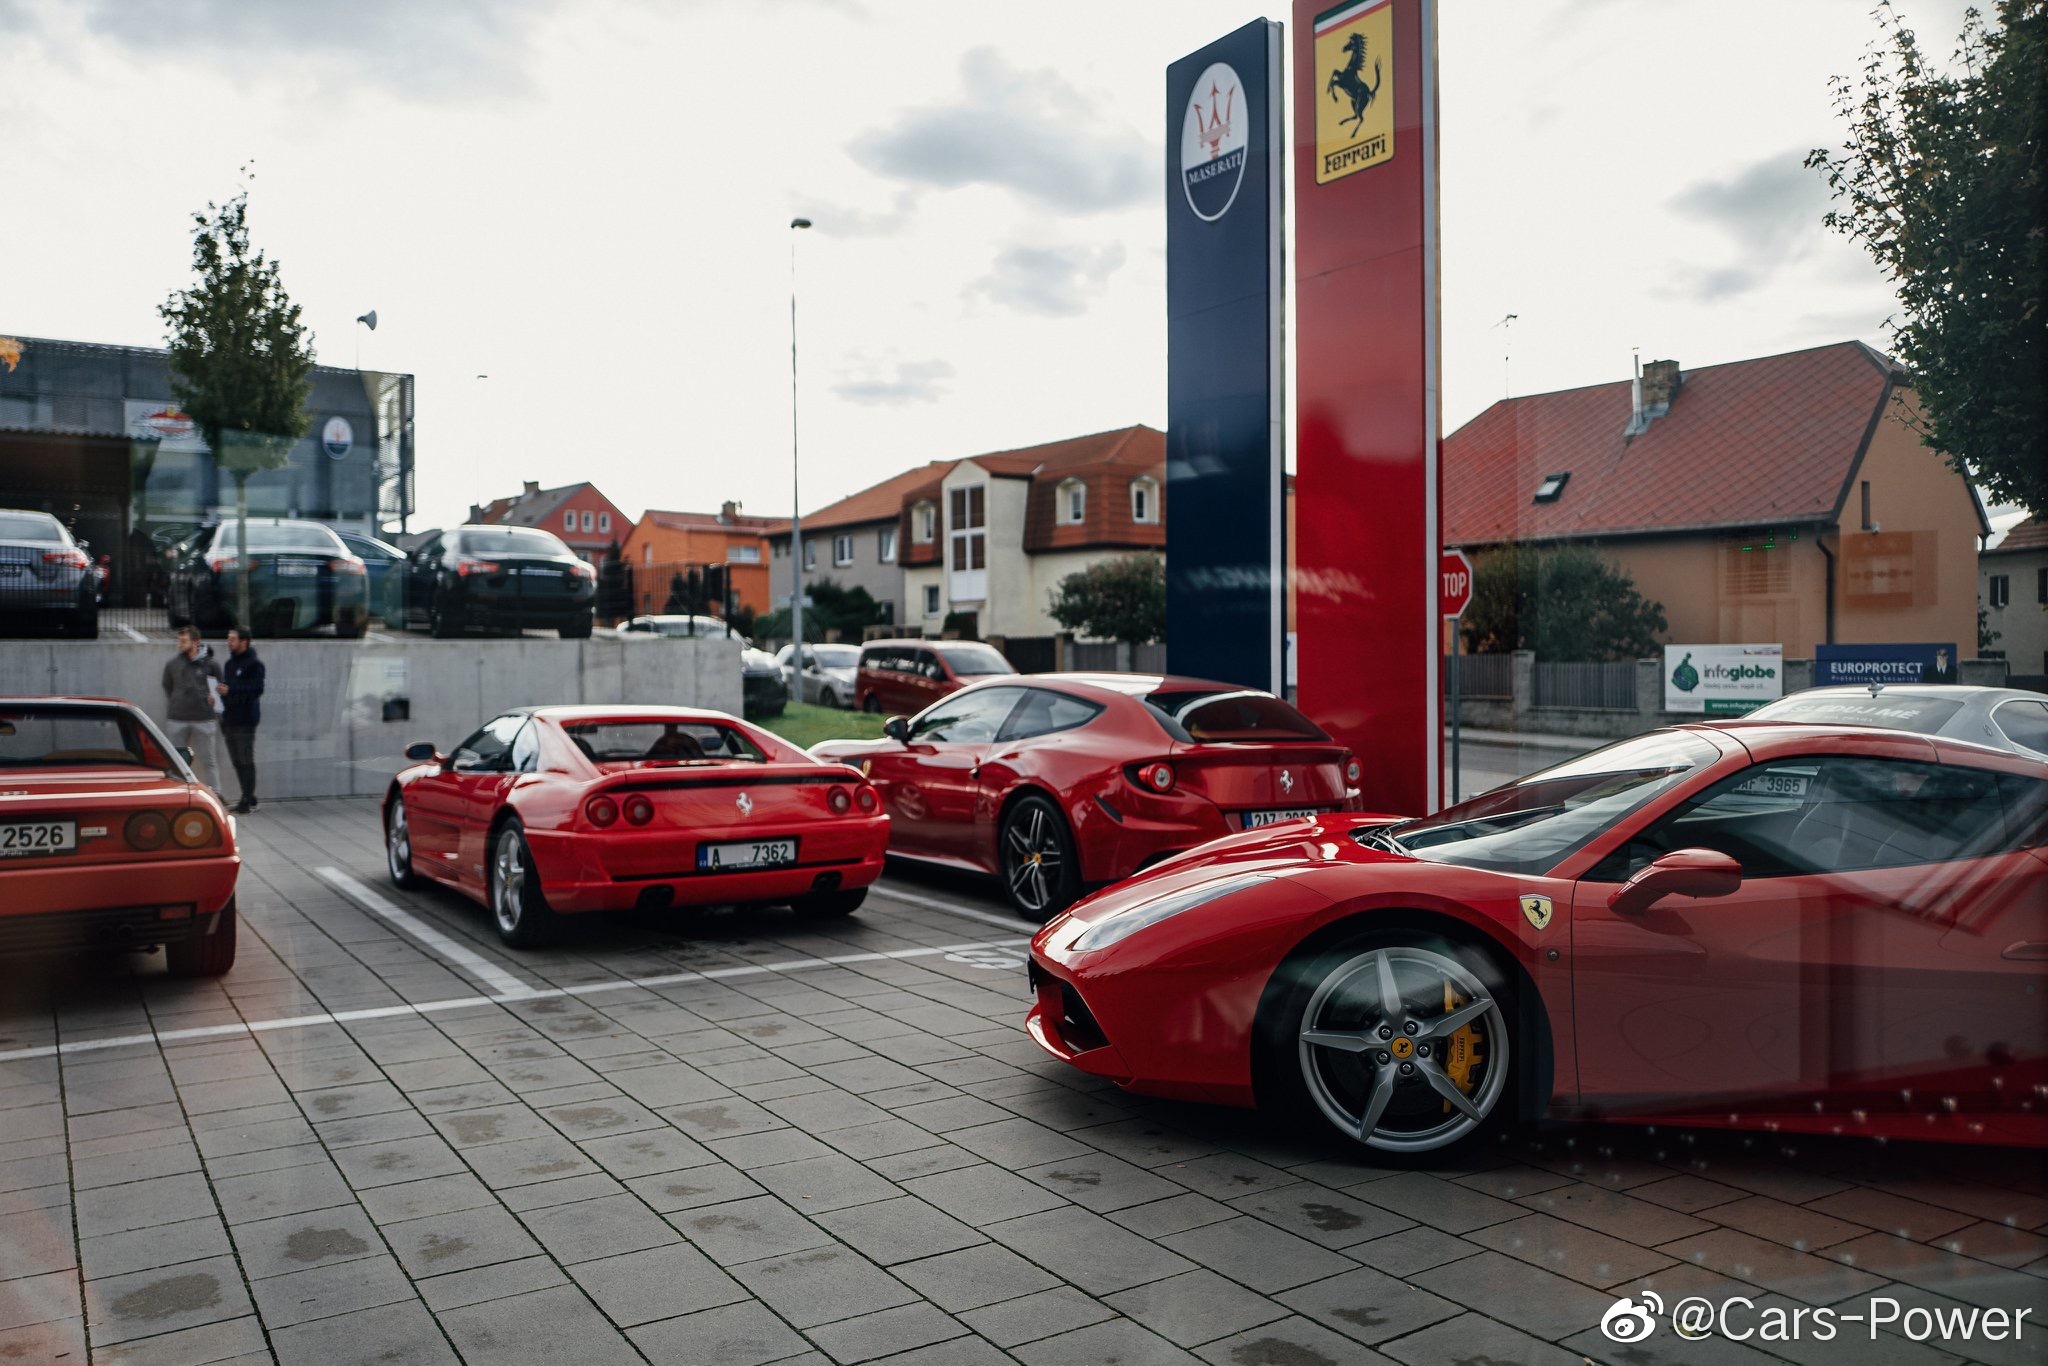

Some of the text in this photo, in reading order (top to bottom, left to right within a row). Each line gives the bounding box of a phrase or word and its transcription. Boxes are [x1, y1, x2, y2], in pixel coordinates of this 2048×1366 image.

[1323, 134, 1386, 175] Ferrari
[1187, 151, 1243, 185] MASERATI
[1443, 572, 1467, 598] TOP
[1704, 664, 1775, 681] infoglobe
[1830, 662, 1923, 674] EUROPROTECT
[1766, 777, 1800, 793] 3965
[3, 825, 64, 848] 2526
[712, 848, 720, 866] A
[752, 843, 788, 863] 7362
